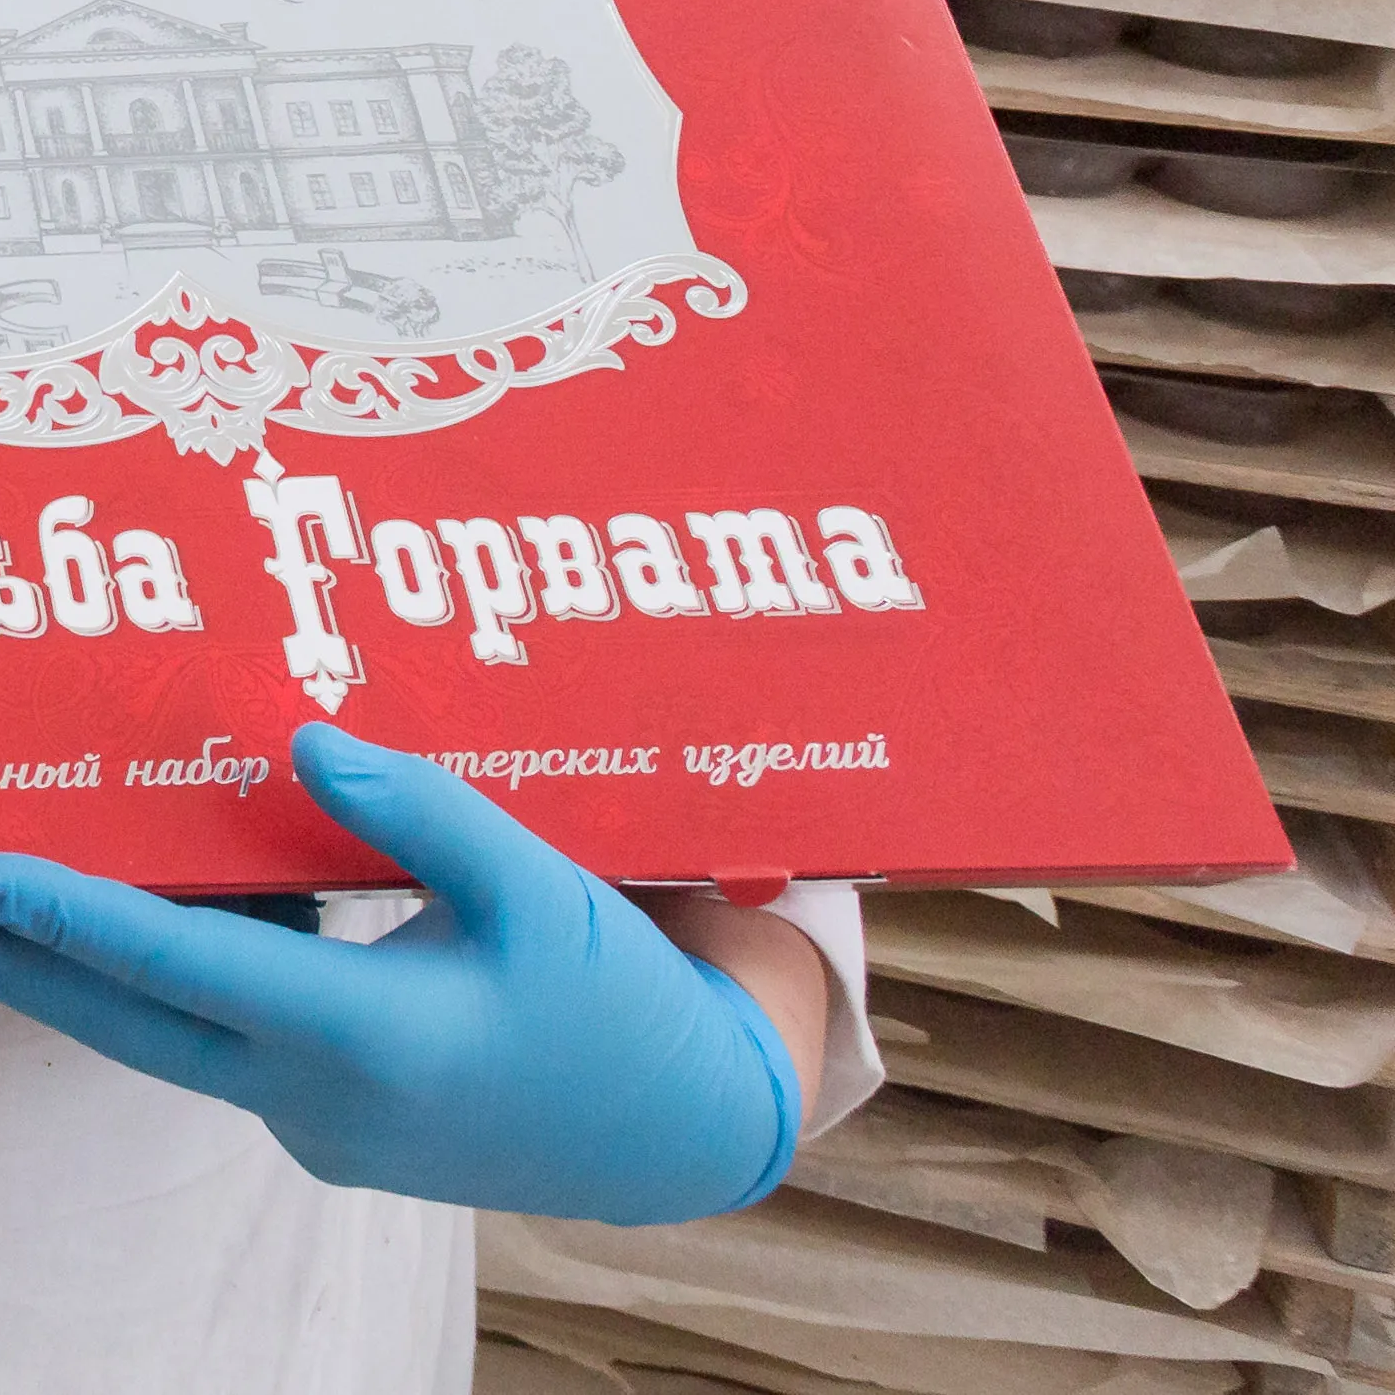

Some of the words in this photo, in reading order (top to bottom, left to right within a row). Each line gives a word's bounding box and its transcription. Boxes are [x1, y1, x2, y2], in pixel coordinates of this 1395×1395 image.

[242, 447, 926, 715] Горвата
[124, 734, 270, 798] набор
[683, 732, 890, 788] изделий
